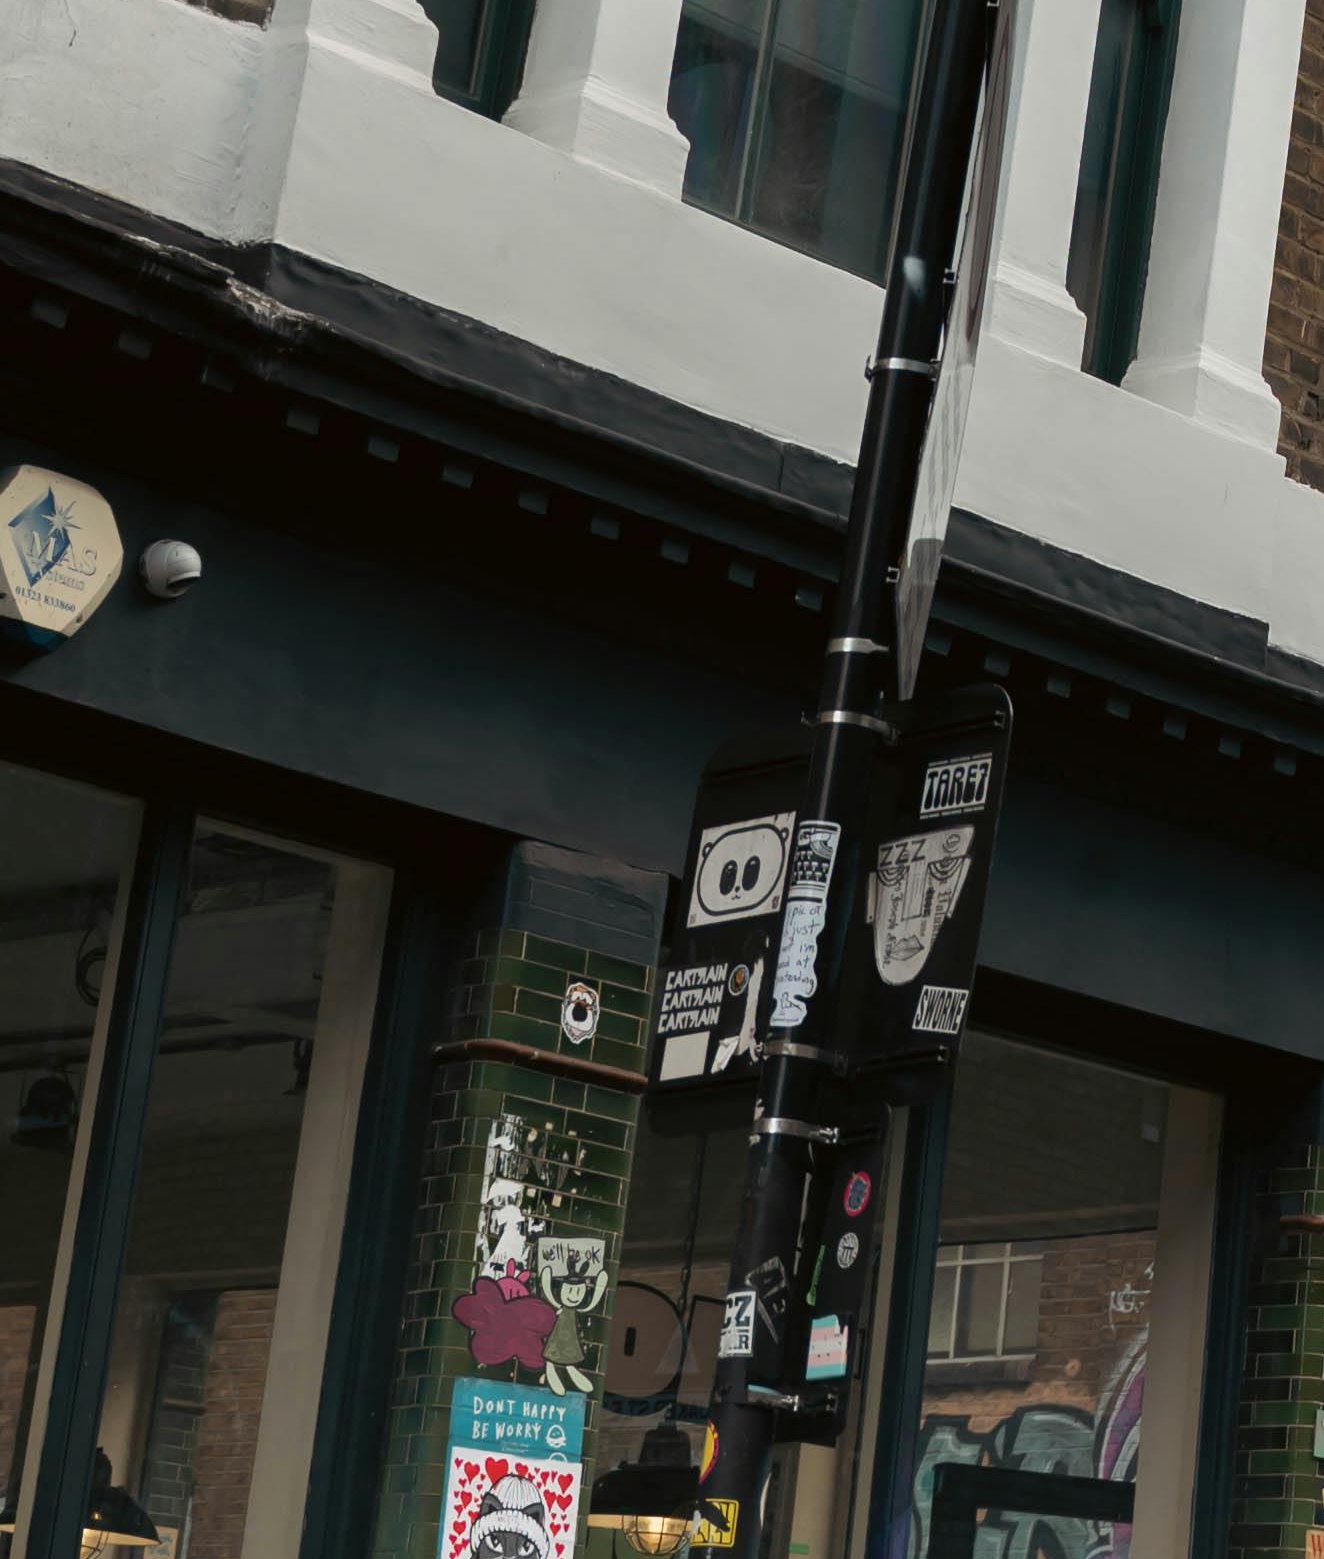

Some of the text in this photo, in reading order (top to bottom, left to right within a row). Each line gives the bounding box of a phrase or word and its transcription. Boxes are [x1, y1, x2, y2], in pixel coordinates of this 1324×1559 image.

[473, 1396, 566, 1422] DONT HAPPY
[472, 1420, 542, 1441] BE WORRY
